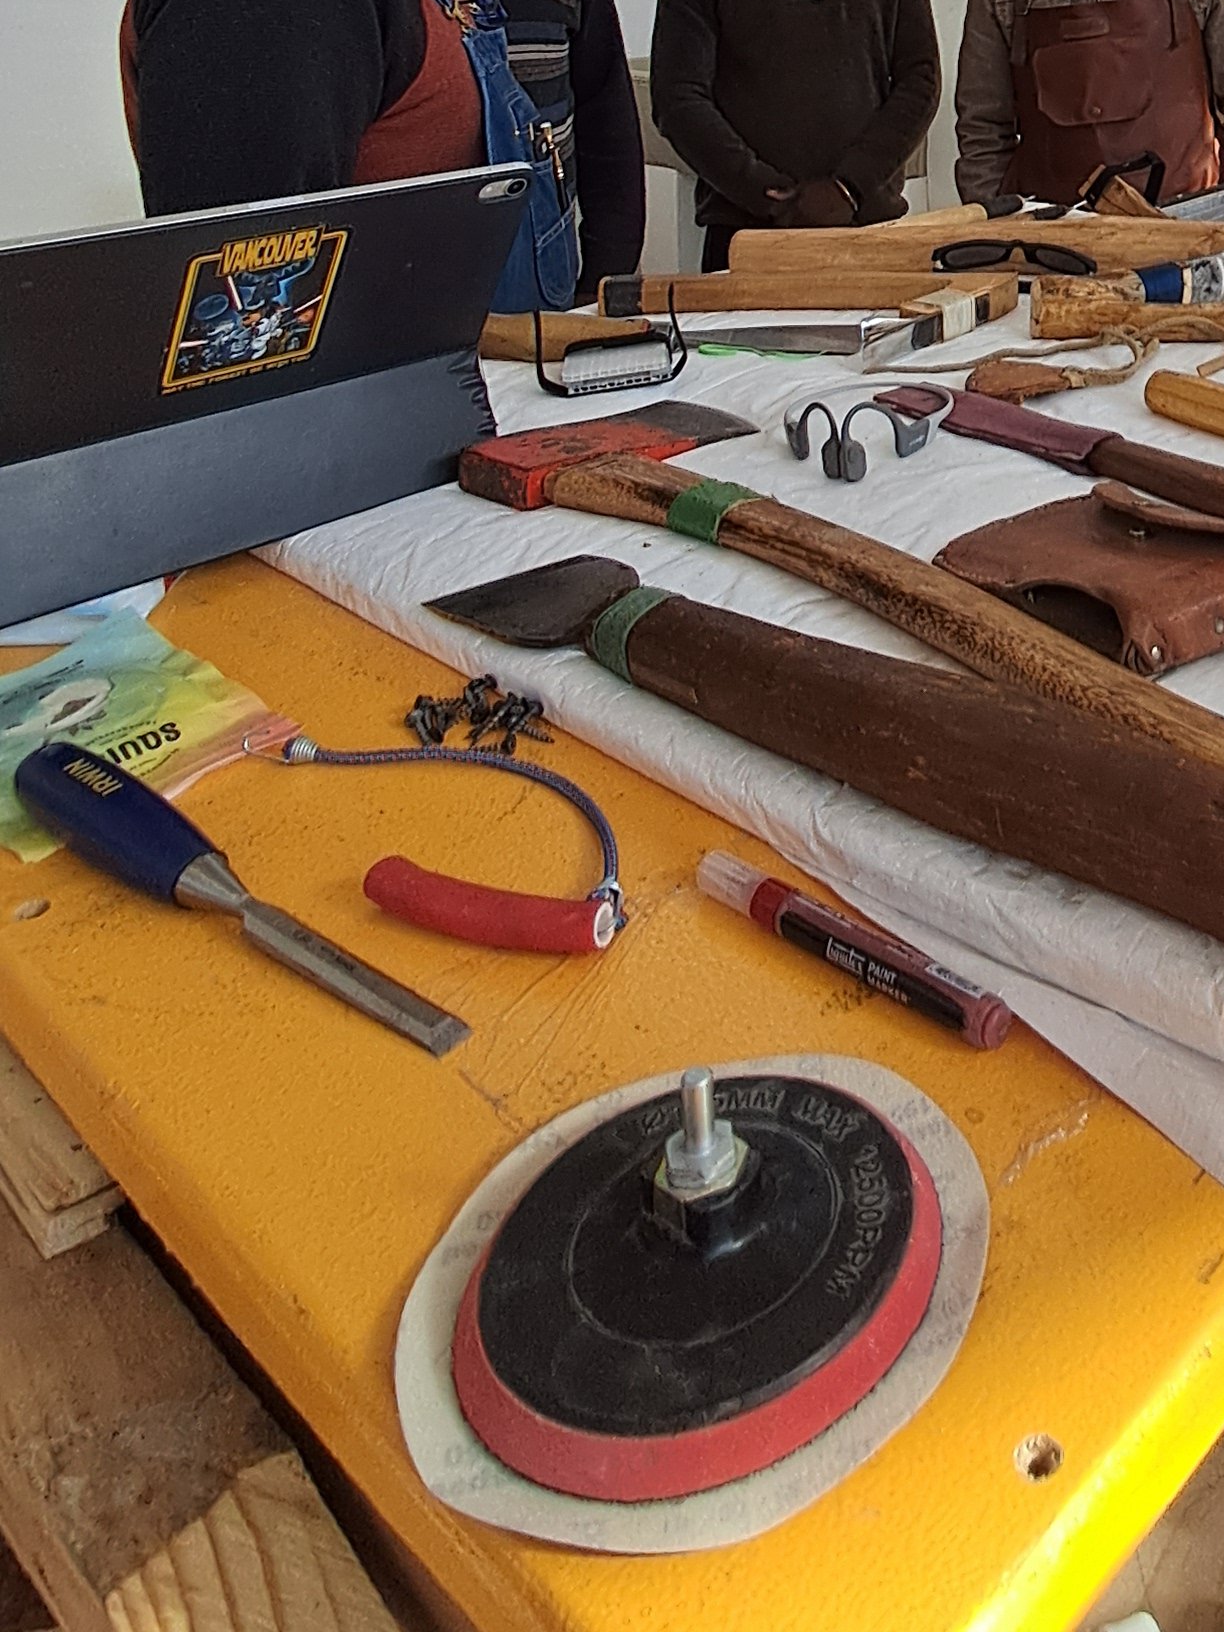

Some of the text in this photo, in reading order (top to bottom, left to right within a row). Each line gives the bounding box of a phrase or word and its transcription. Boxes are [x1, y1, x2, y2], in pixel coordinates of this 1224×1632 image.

[220, 230, 319, 272] VANCOUVER
[105, 721, 182, 765] SQUI
[63, 757, 124, 798] IRWIN
[867, 961, 897, 985] PAINT
